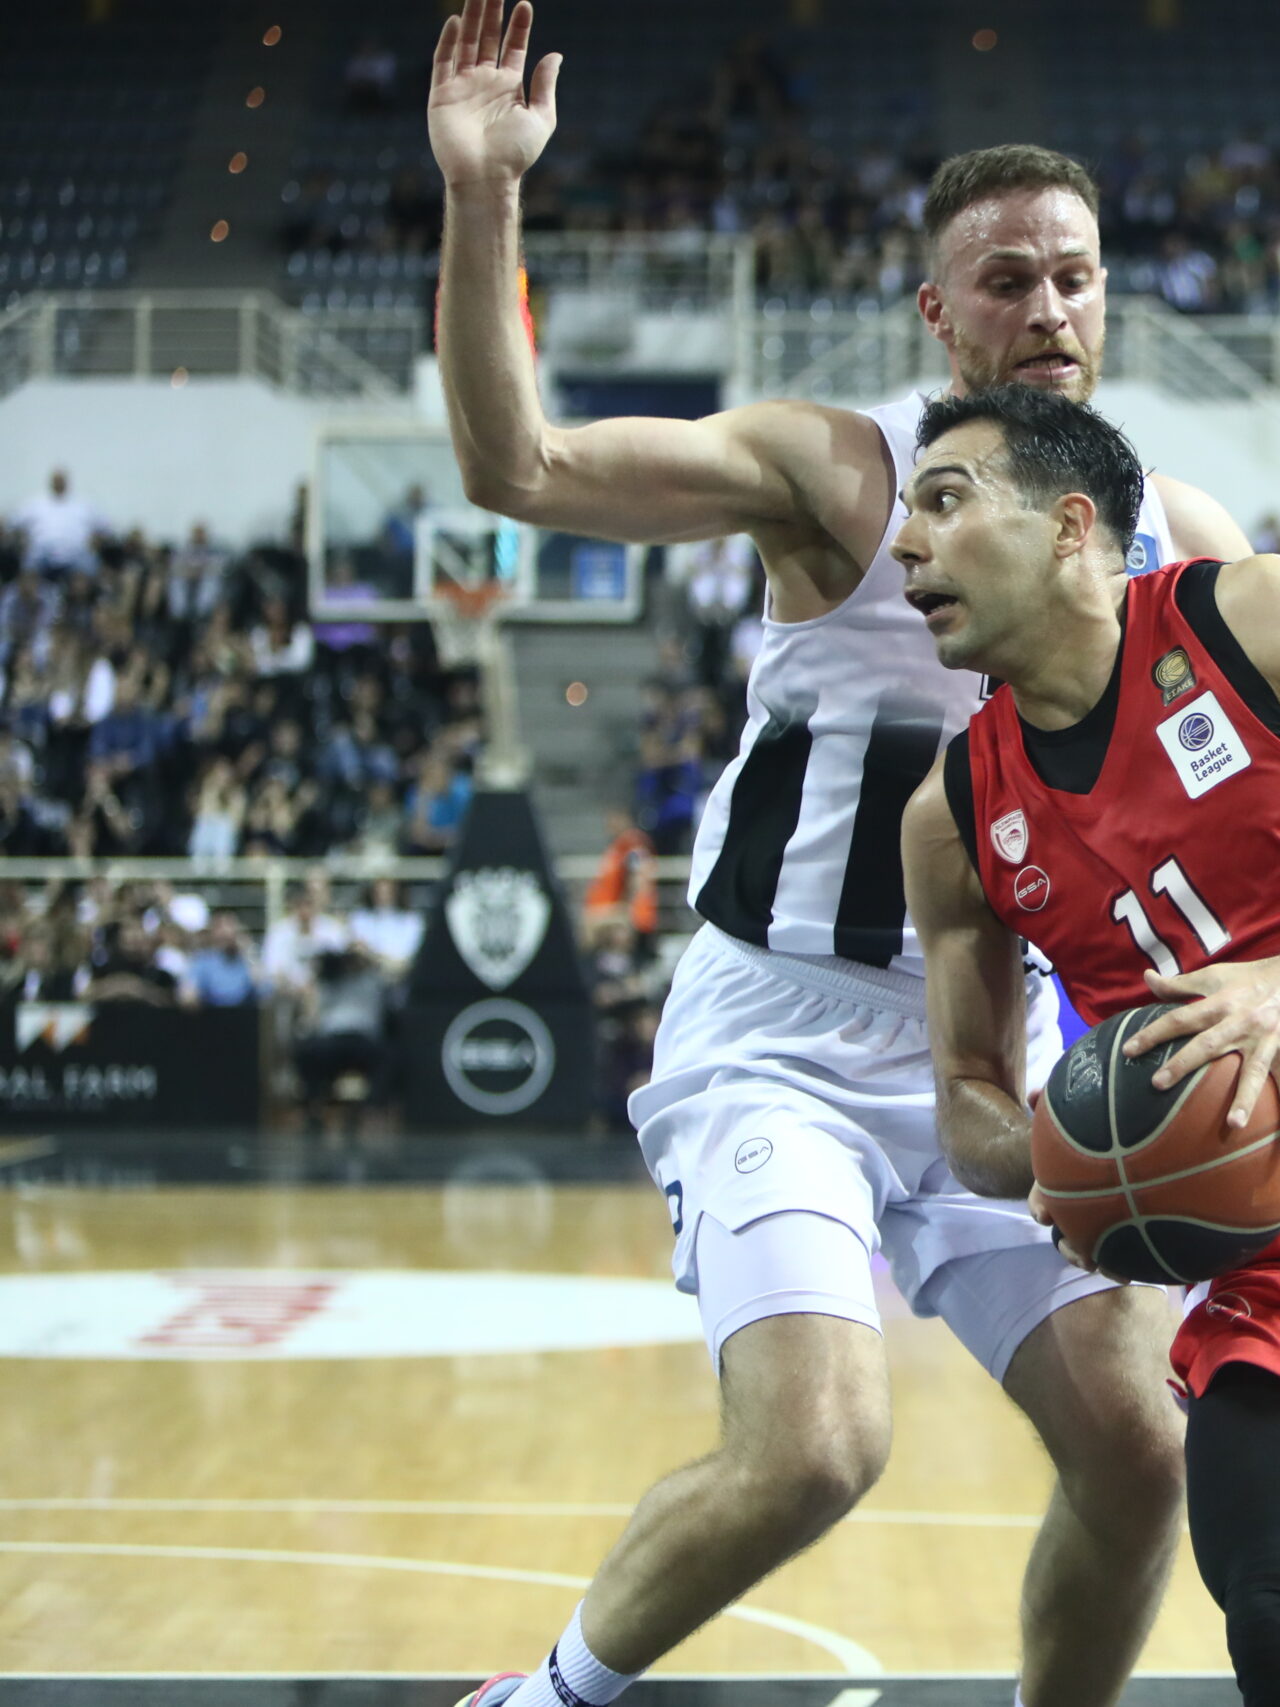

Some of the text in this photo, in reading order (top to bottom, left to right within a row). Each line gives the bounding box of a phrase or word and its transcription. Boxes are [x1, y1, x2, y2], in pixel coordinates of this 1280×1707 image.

[1190, 742, 1228, 772] Basket
[1195, 753, 1233, 782] League
[1018, 878, 1046, 899] GSA
[1111, 855, 1232, 977] 11
